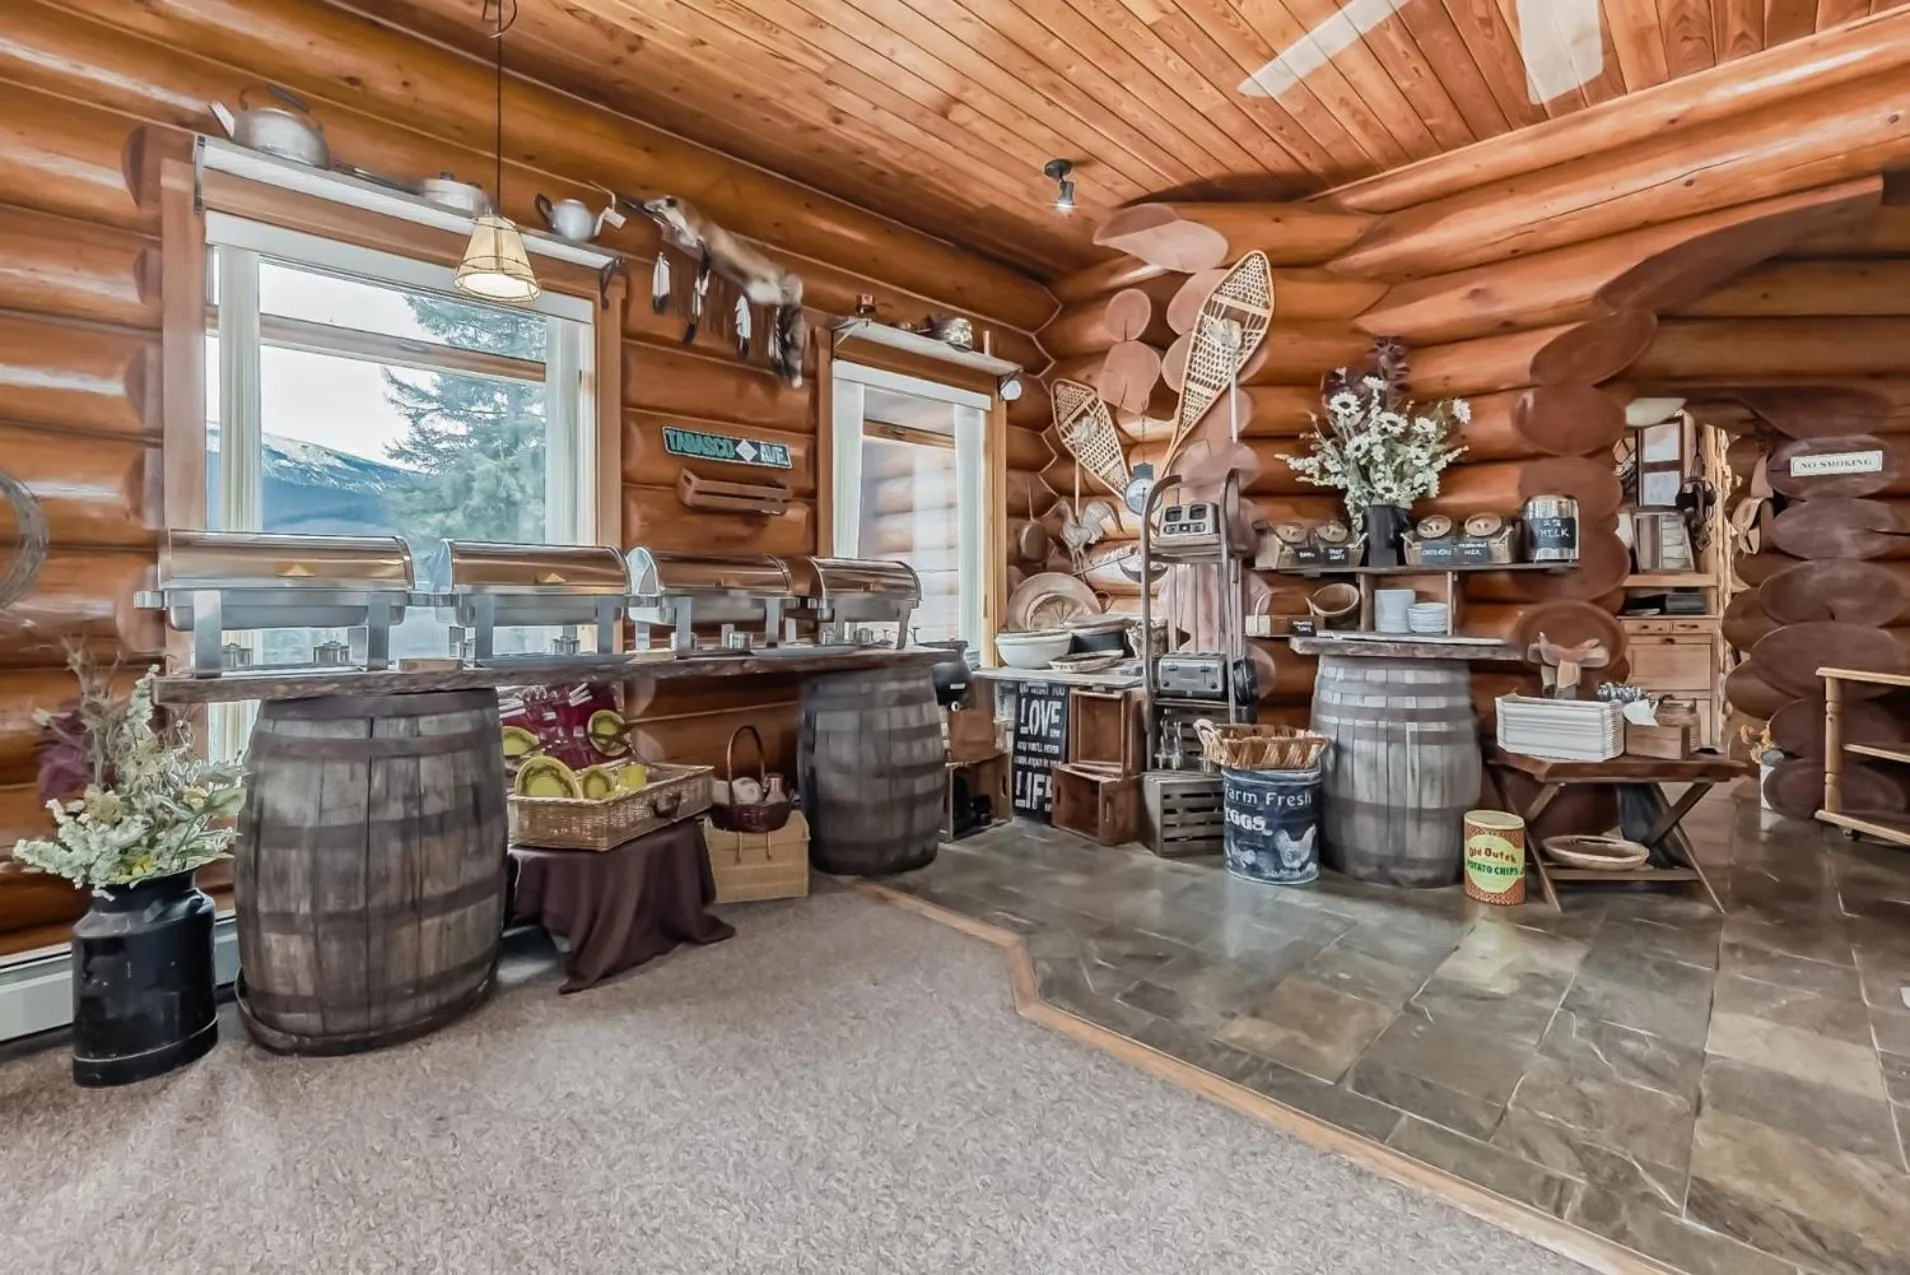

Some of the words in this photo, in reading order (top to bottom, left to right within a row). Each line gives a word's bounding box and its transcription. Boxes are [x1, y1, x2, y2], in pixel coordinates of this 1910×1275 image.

[665, 430, 736, 458] TABASCO
[1820, 459, 1873, 468] SMOKING
[1019, 698, 1062, 738] LOVE
[1265, 790, 1312, 807] Fresh
[1484, 847, 1516, 864] Dutch
[1494, 866, 1519, 876] CHIPS
